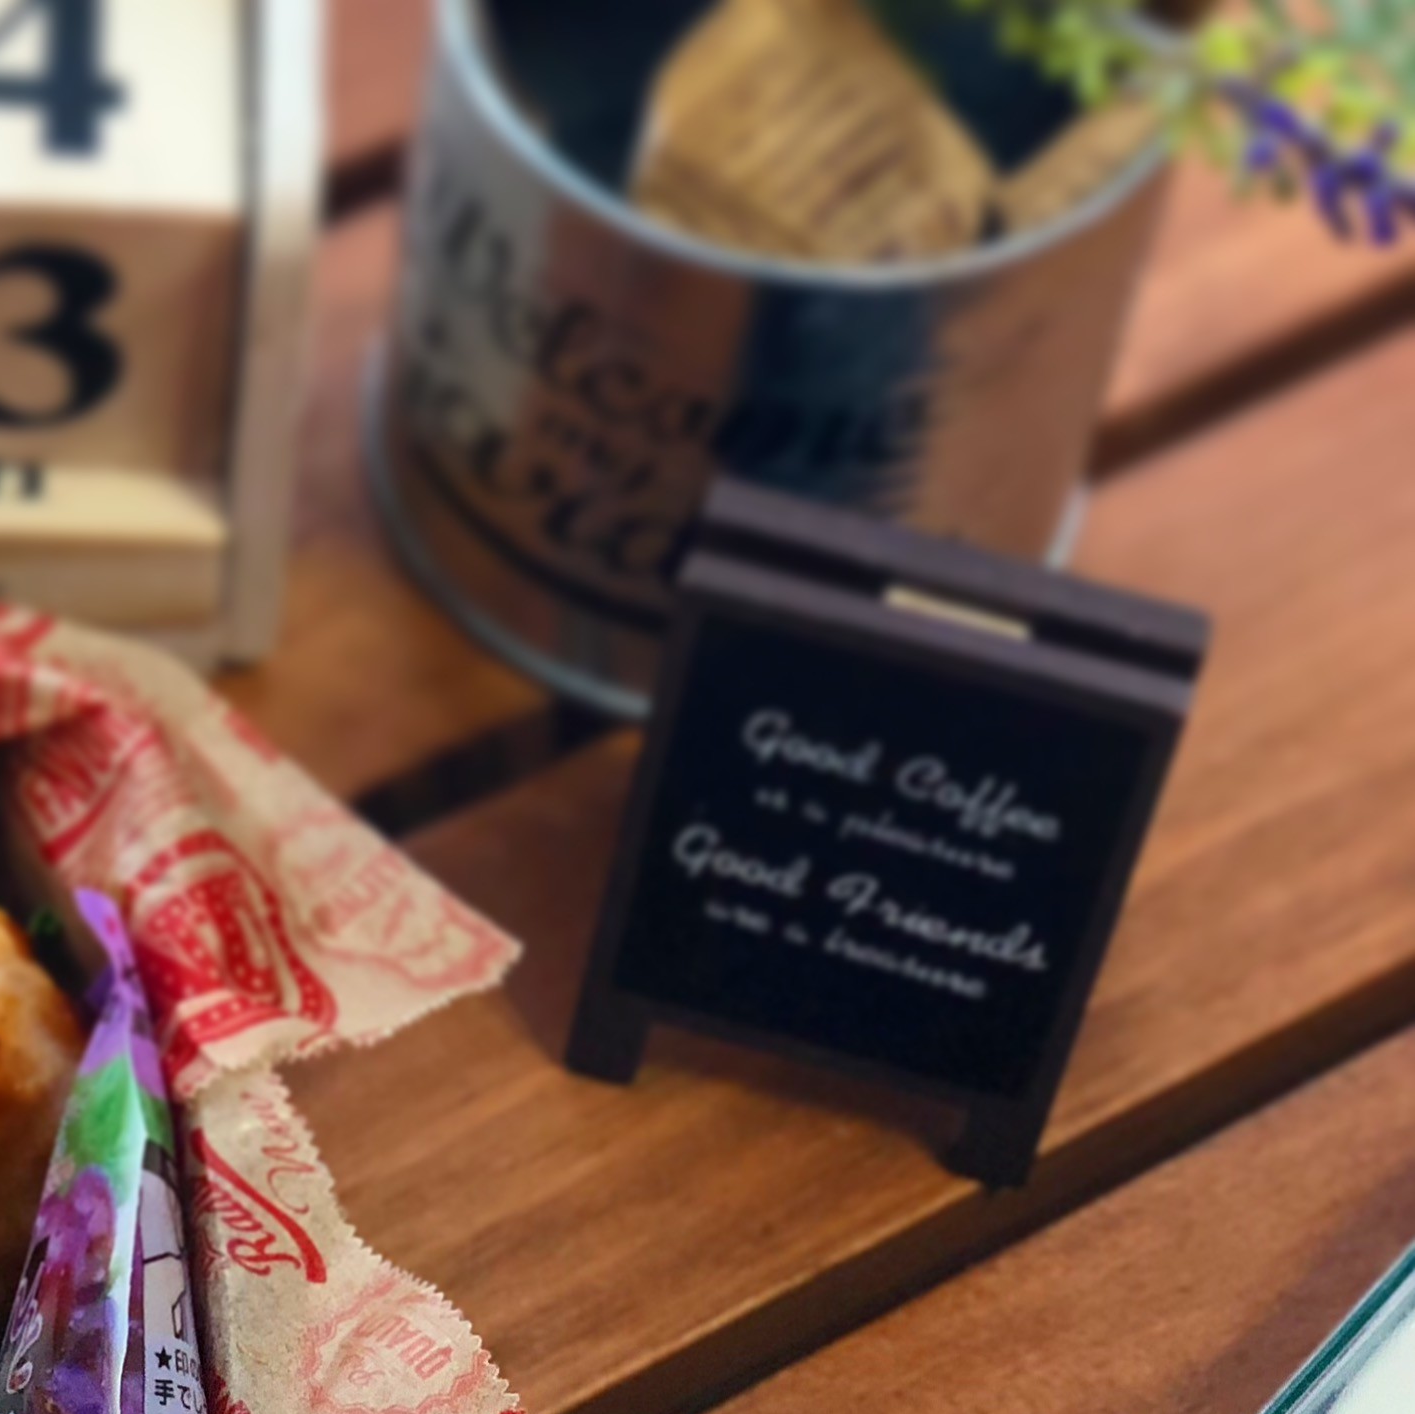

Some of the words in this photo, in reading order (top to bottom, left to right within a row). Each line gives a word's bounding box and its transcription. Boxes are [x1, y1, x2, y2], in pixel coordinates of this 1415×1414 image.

[742, 709, 880, 783] Good
[895, 756, 1061, 841] Coffee
[672, 824, 811, 898] Good
[827, 872, 1050, 971] Friends
[824, 924, 987, 998] treasure
